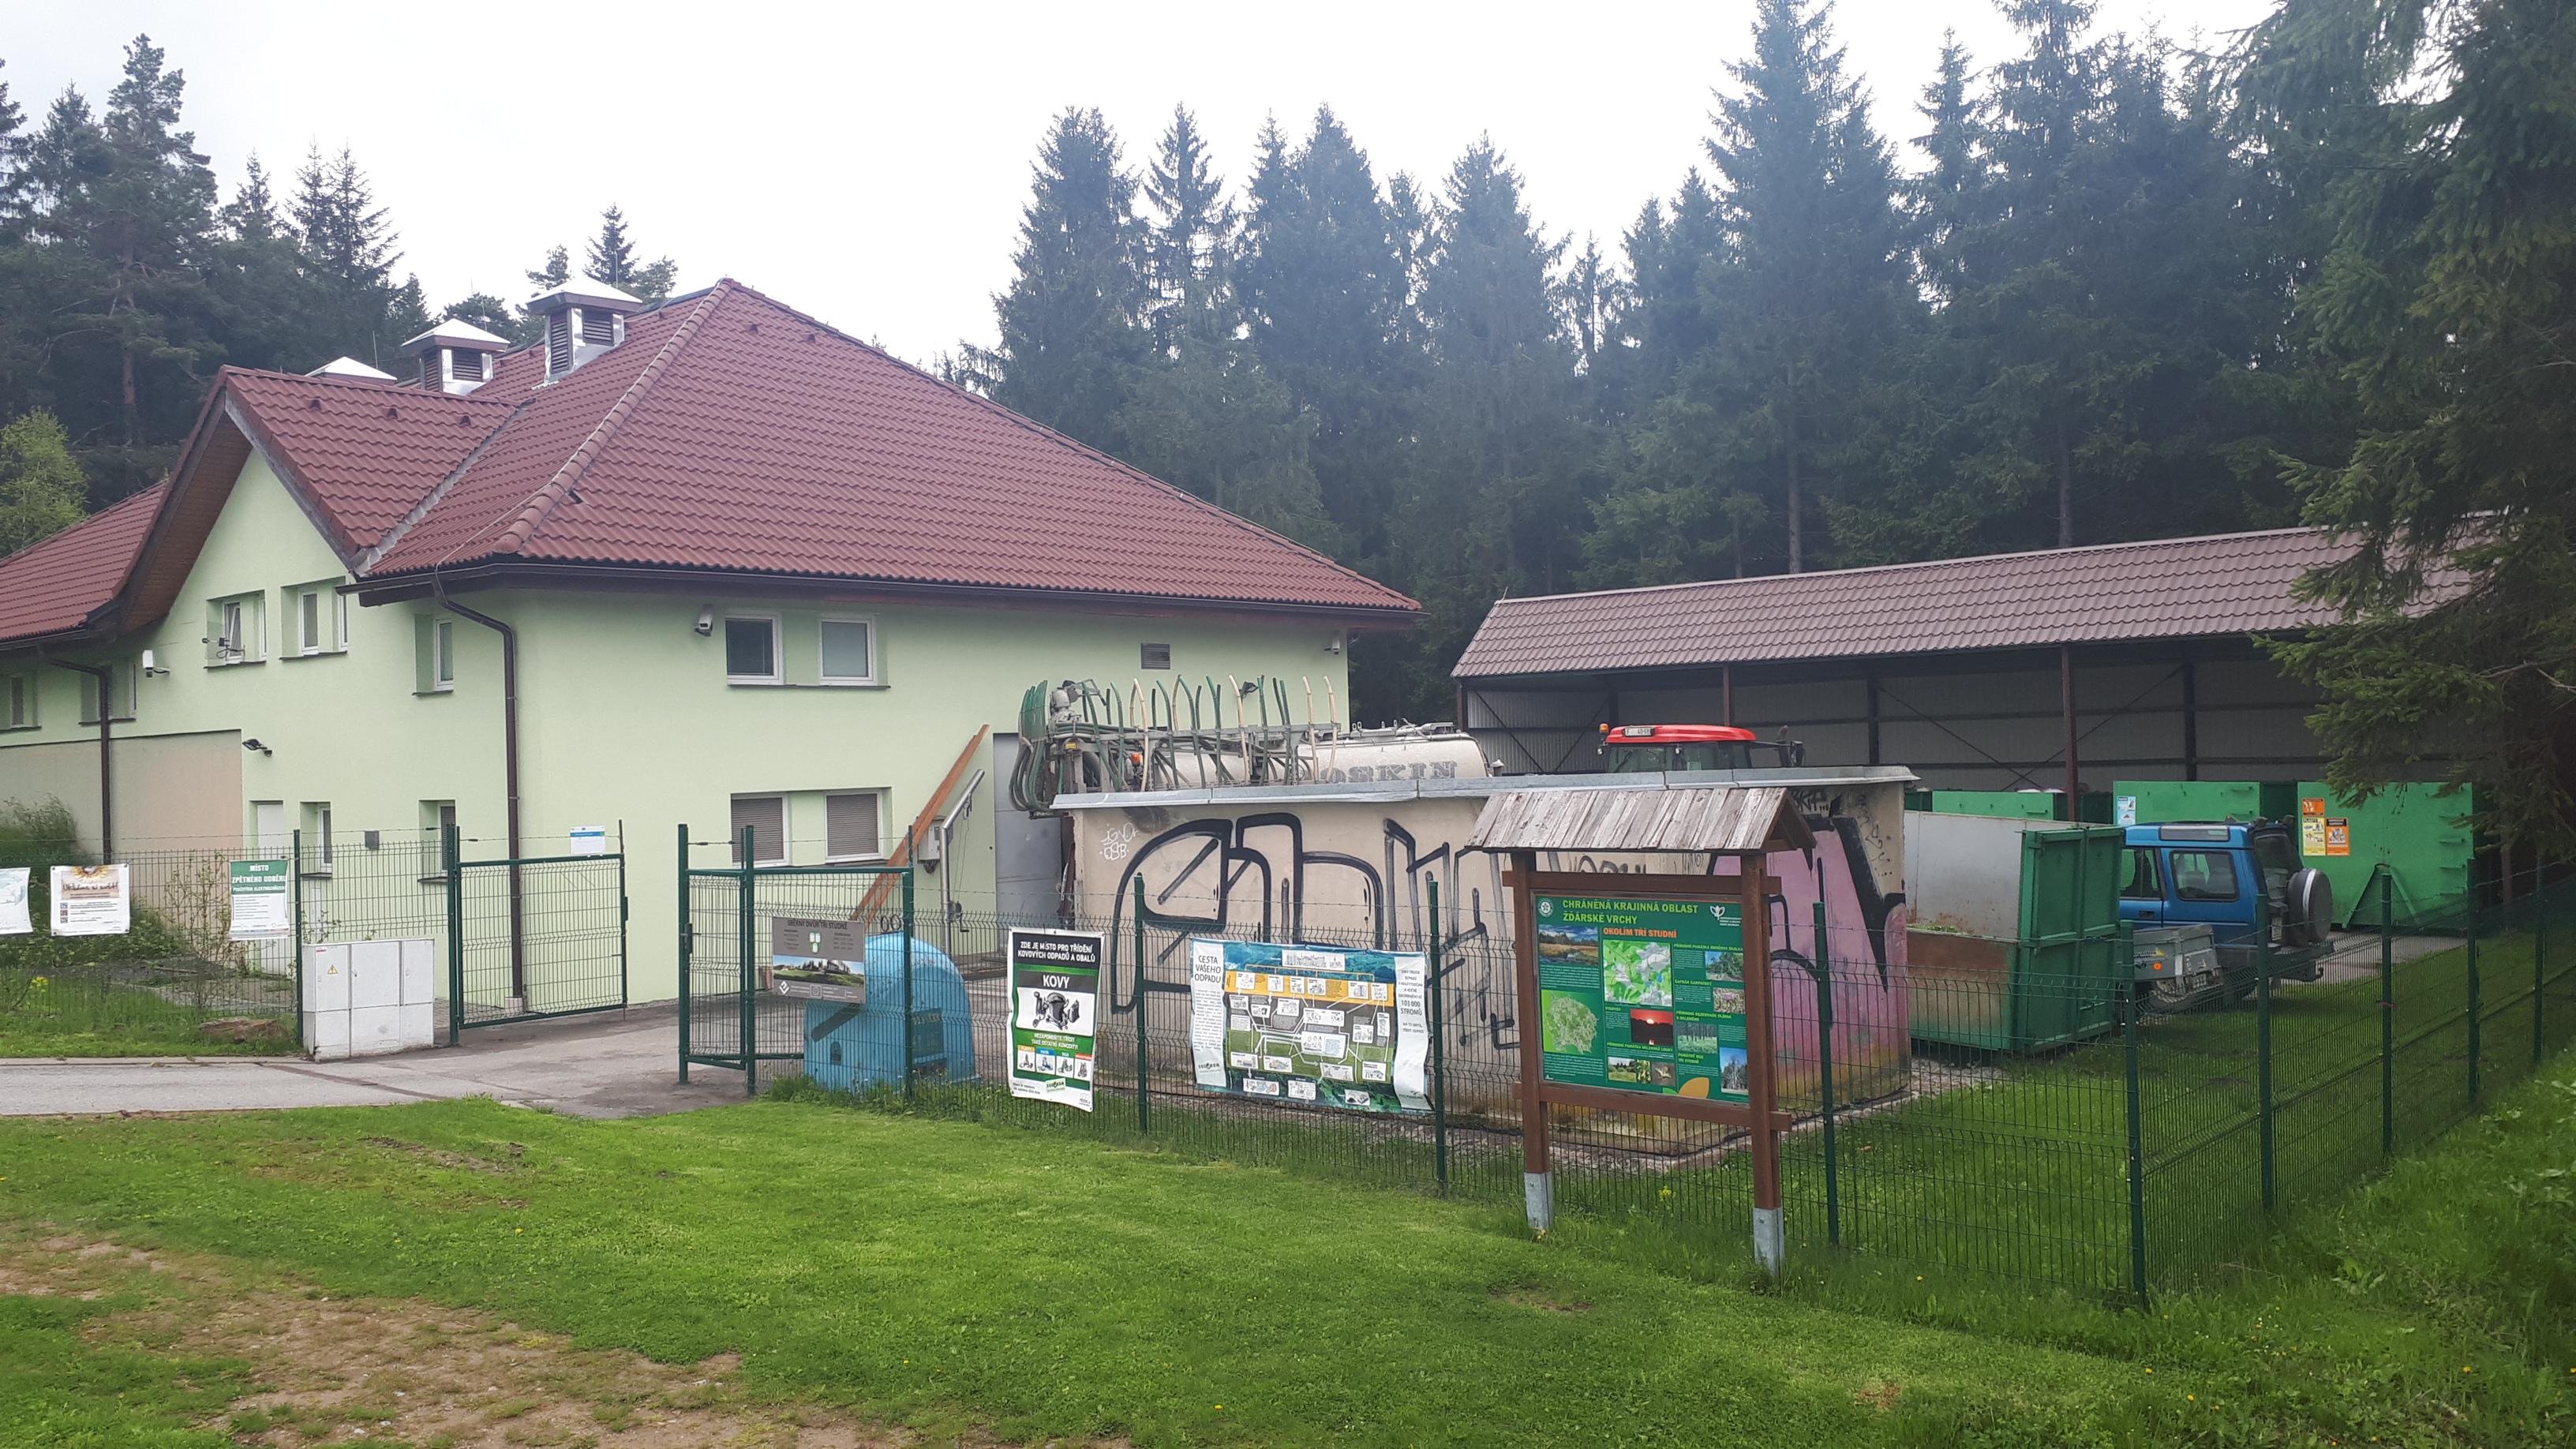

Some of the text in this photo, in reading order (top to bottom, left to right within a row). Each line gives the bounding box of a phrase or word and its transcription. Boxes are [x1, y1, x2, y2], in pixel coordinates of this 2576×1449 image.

[1304, 760, 1458, 783] OSKIN
[1563, 899, 1698, 913] CHRÁNĚNÁ KRAJINNÁ OBLAST
[1563, 911, 1638, 924] ŽĎÁRSKÉ VRCHY
[1603, 926, 1677, 938] OKOLÍM TŘÍ STUDNÍ
[1039, 941, 1057, 951] MÍSTO
[1069, 943, 1093, 953] TŘÍDĚNÍ
[1017, 949, 1046, 959] KOVOVÝCH
[1046, 951, 1070, 960] ODPADŮ
[1076, 953, 1096, 963] OBALŮ
[1198, 955, 1219, 964] CESTA
[1196, 964, 1222, 974] VAŠEHO
[1043, 975, 1070, 989] KOVY
[1194, 973, 1222, 983] ODPADU
